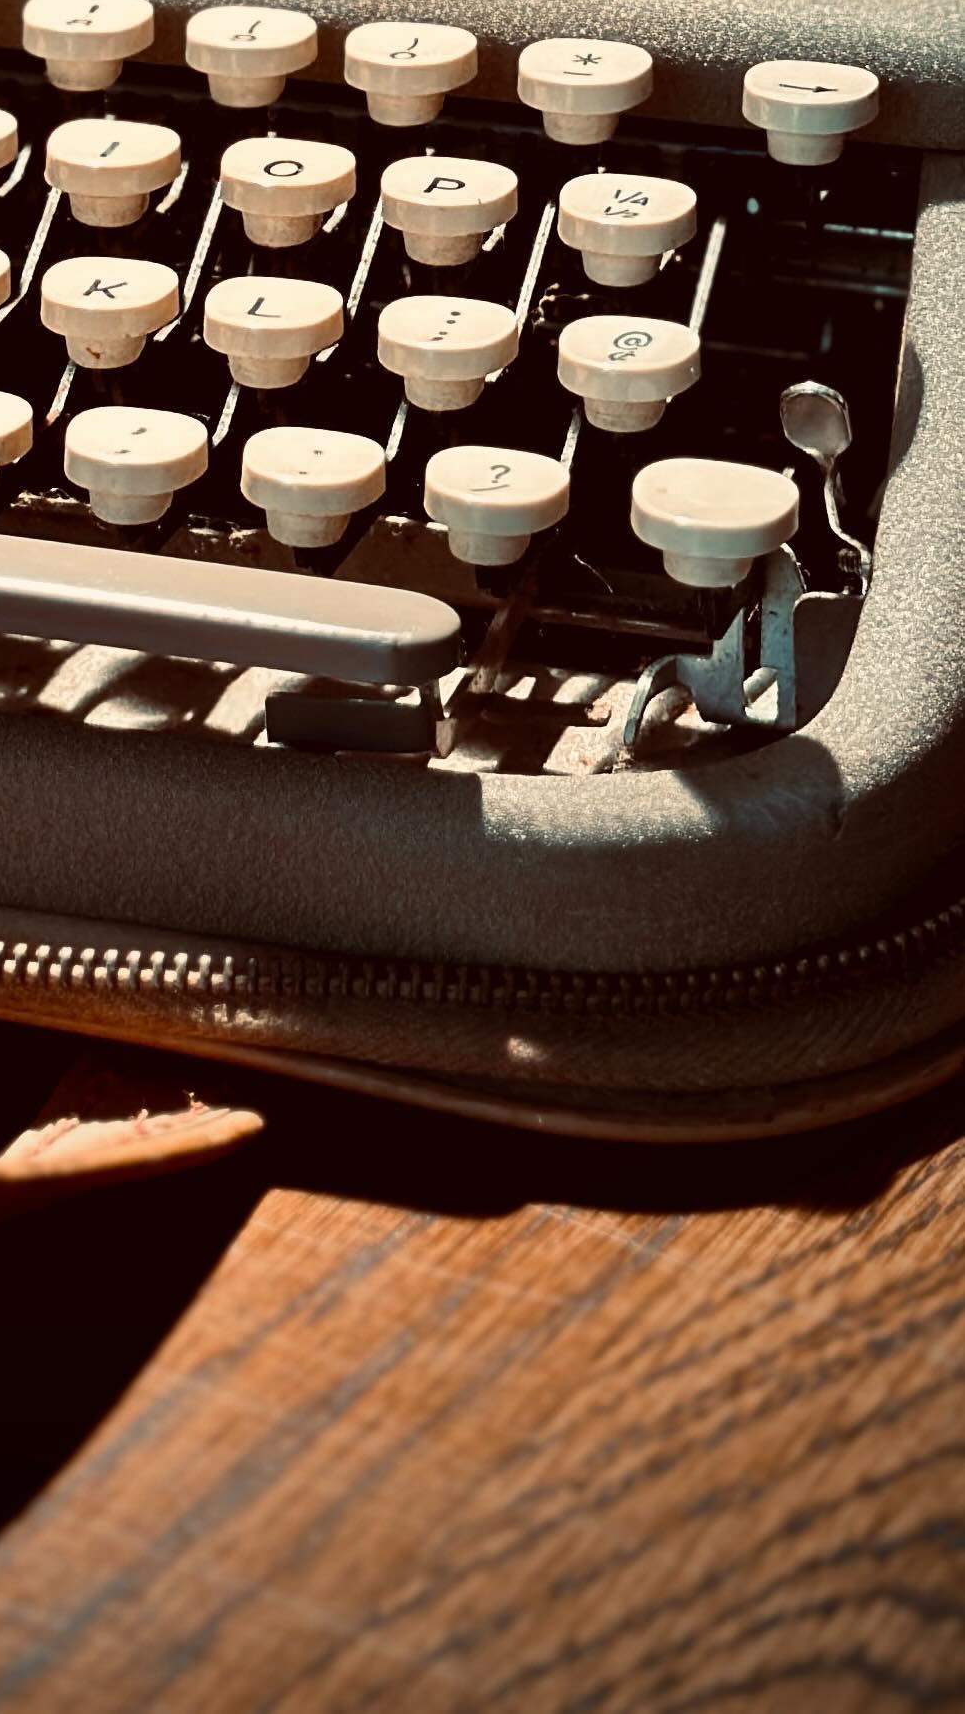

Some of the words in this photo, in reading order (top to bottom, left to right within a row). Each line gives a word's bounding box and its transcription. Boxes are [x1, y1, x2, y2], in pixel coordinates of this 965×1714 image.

[99, 141, 120, 158] I
[263, 160, 304, 178] O
[423, 177, 466, 194] P
[82, 279, 128, 300] K
[246, 296, 280, 318] L
[612, 330, 654, 351] @
[490, 464, 512, 485] ?
